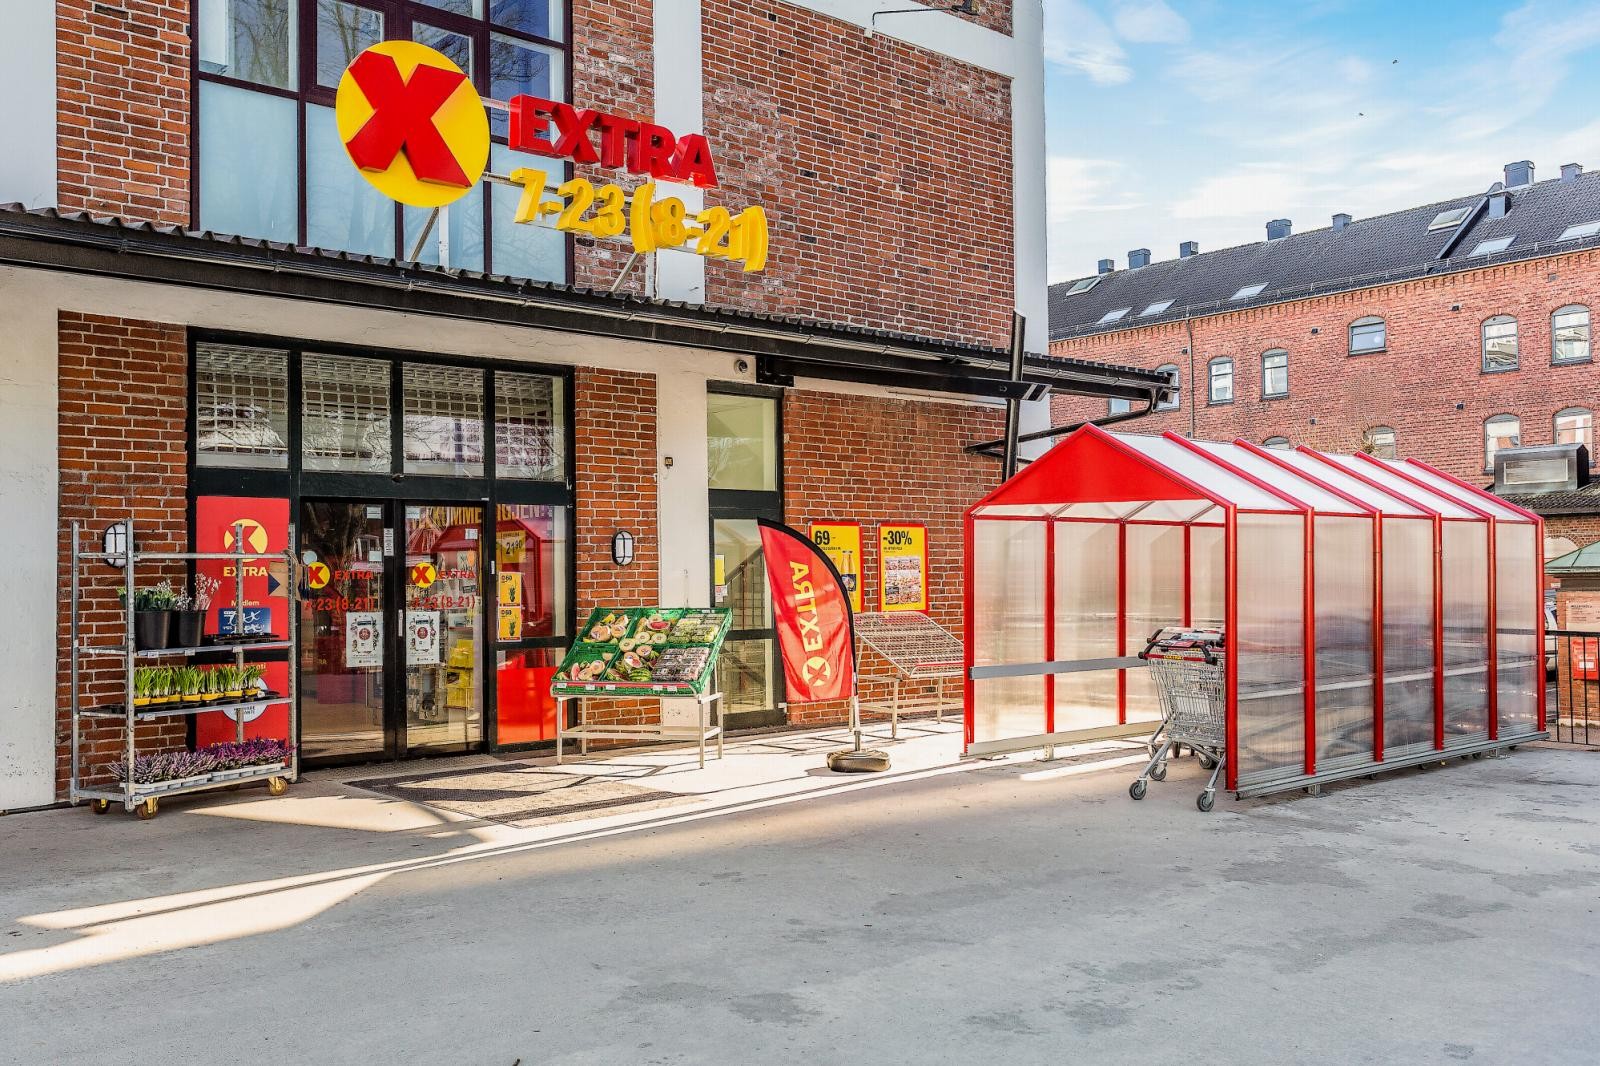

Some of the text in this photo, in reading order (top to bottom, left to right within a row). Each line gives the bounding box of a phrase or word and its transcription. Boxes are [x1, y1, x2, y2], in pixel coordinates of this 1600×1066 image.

[509, 94, 718, 189] EXTRA
[883, 530, 912, 545] -30%
[334, 570, 374, 580] EXTRA
[440, 570, 476, 579] EXTRA
